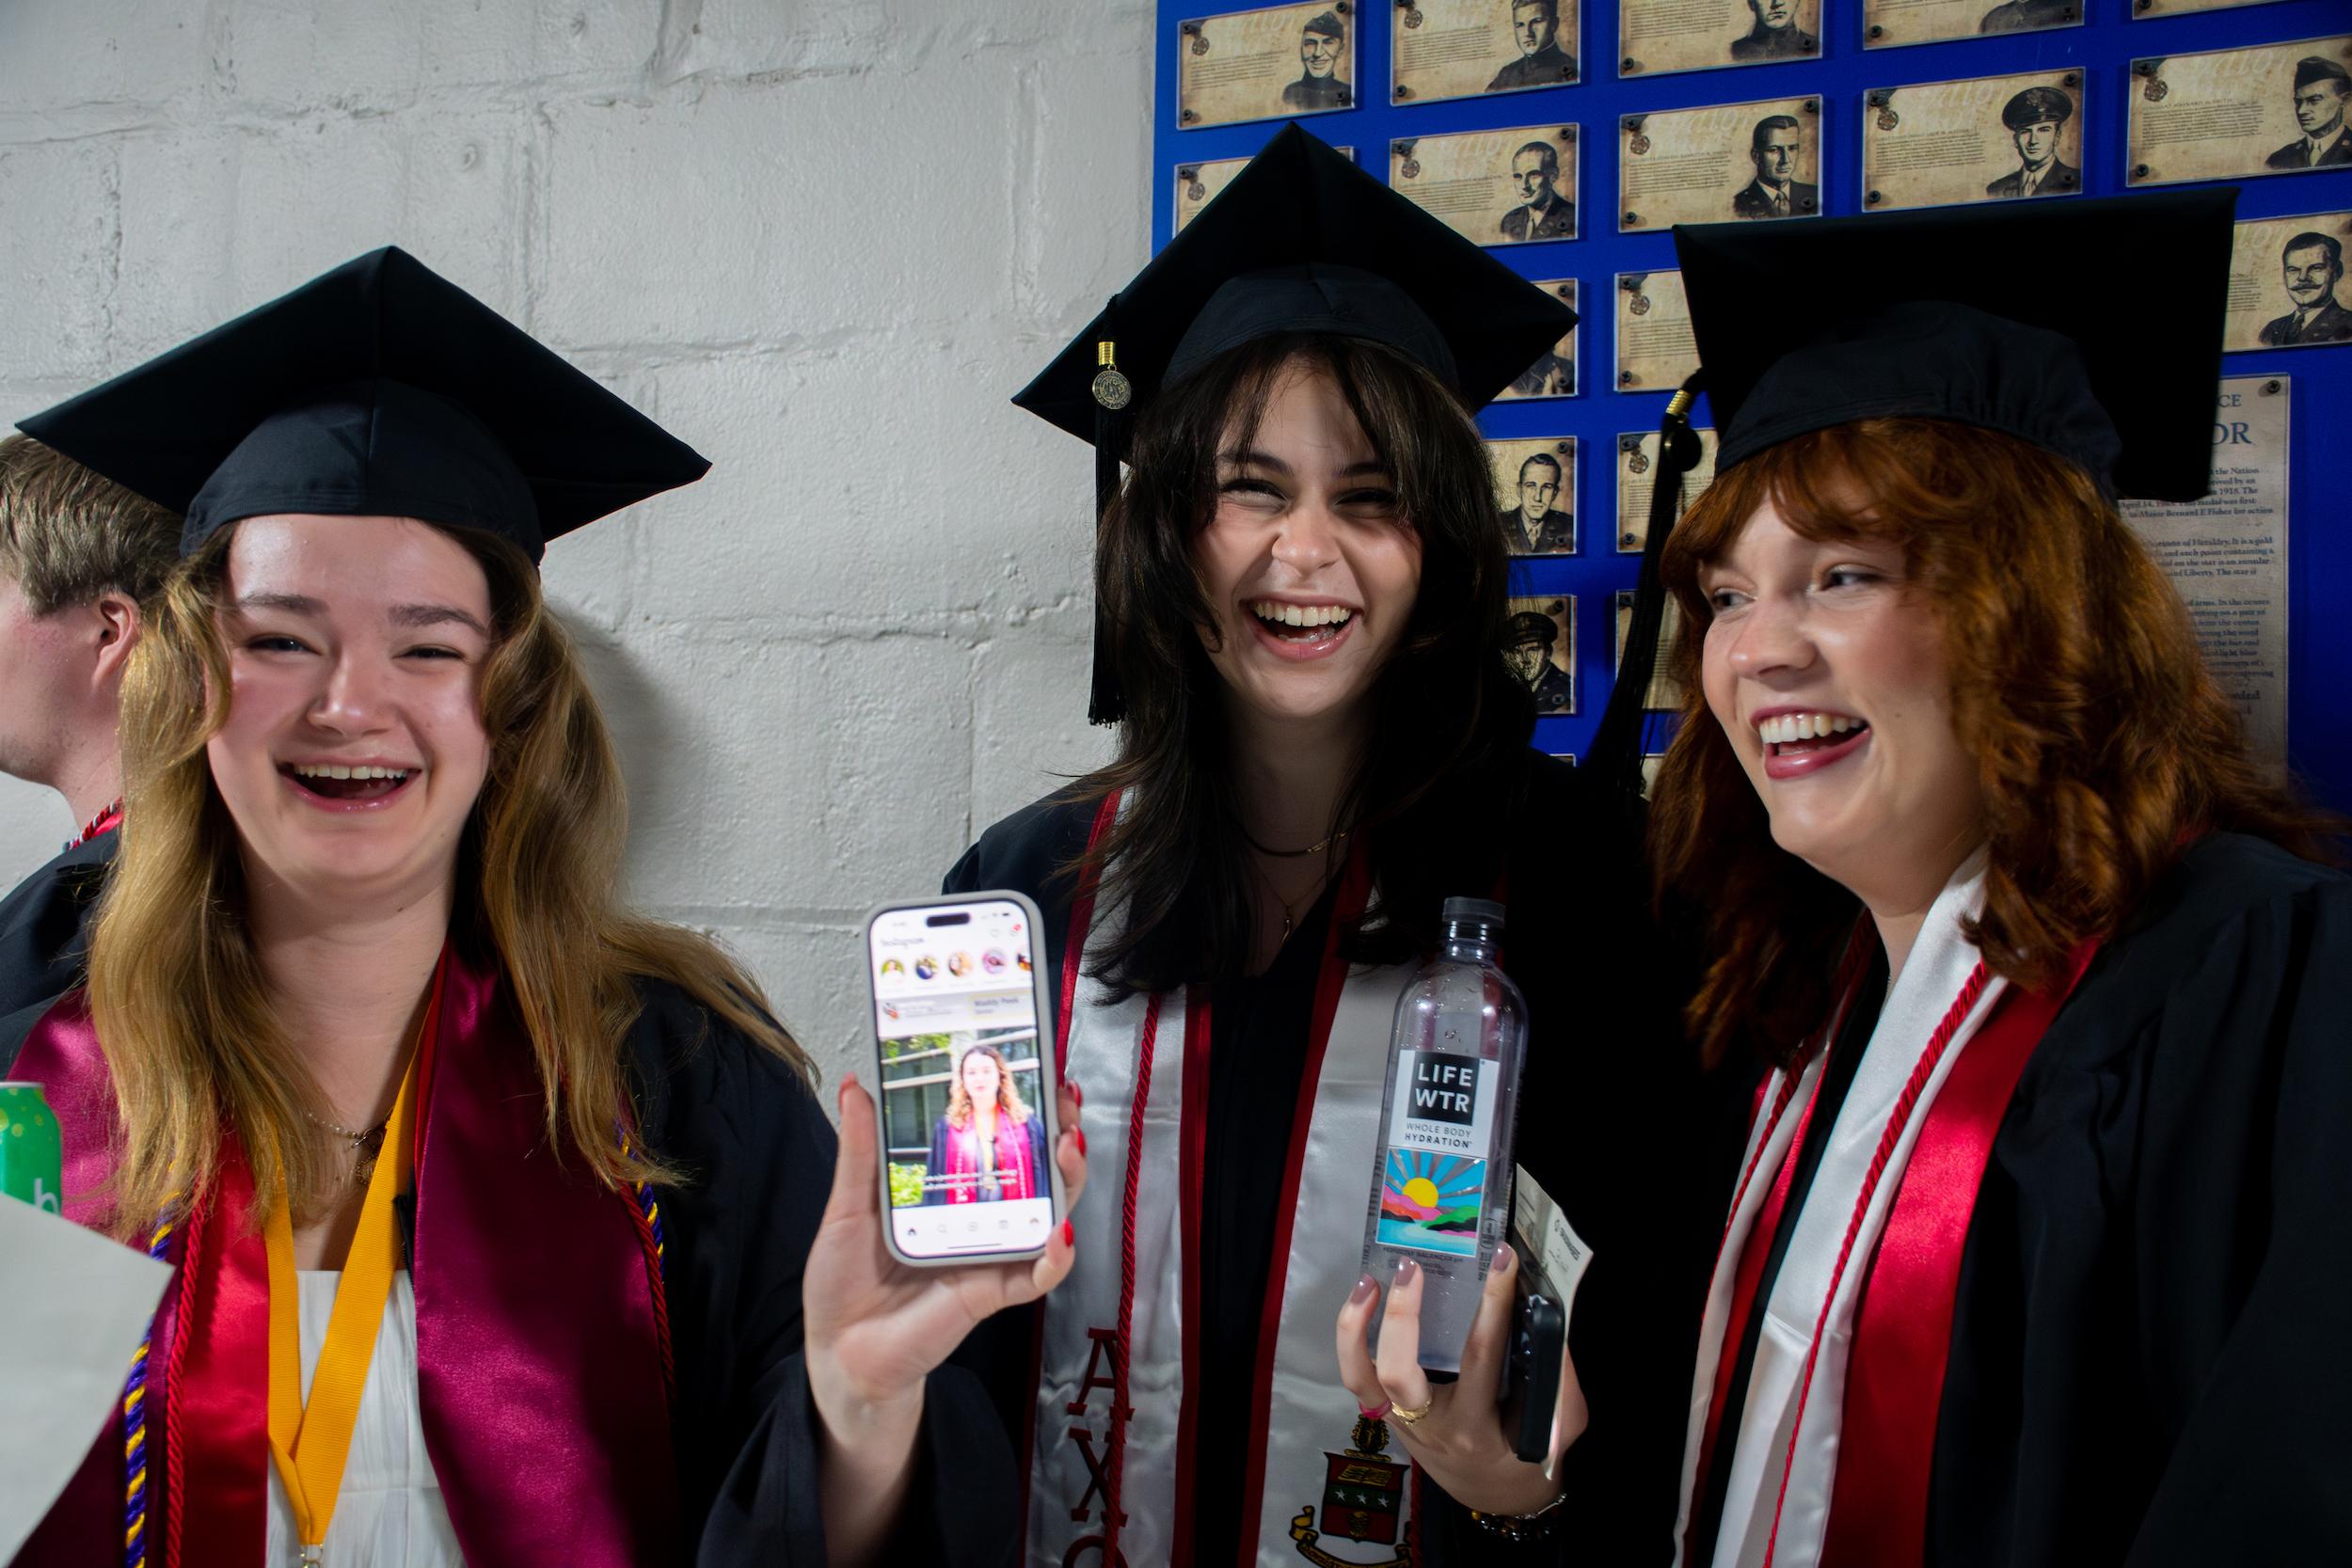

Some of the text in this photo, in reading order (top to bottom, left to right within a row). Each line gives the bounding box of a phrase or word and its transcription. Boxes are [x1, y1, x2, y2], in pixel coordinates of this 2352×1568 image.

[1418, 1062, 1473, 1087] LIFE
[1415, 1087, 1470, 1113] WTR
[1406, 1122, 1471, 1137] WHOLE BODY
